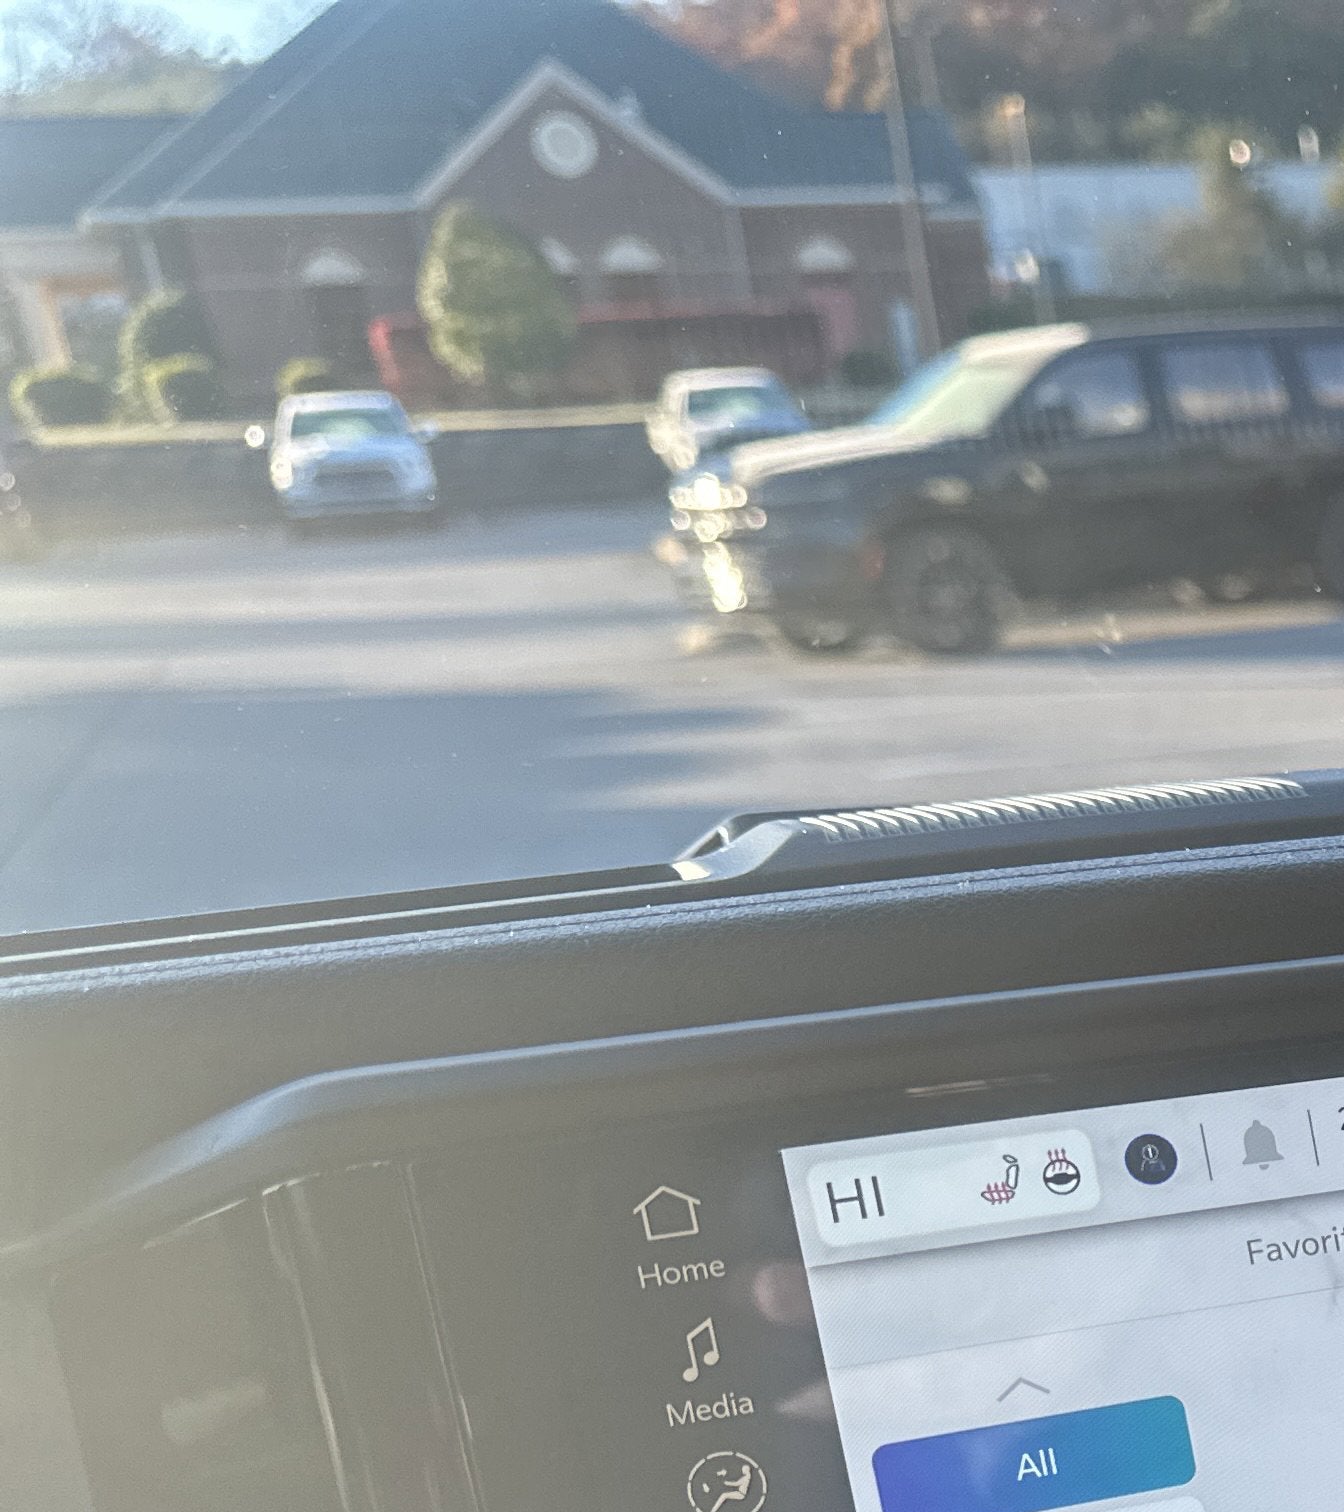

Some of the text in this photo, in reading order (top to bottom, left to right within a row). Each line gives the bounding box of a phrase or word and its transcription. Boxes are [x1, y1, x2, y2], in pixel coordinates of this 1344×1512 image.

[825, 1175, 886, 1223] HI
[637, 1256, 726, 1289] Home
[665, 1393, 755, 1427] Media
[1016, 1448, 1058, 1482] All
